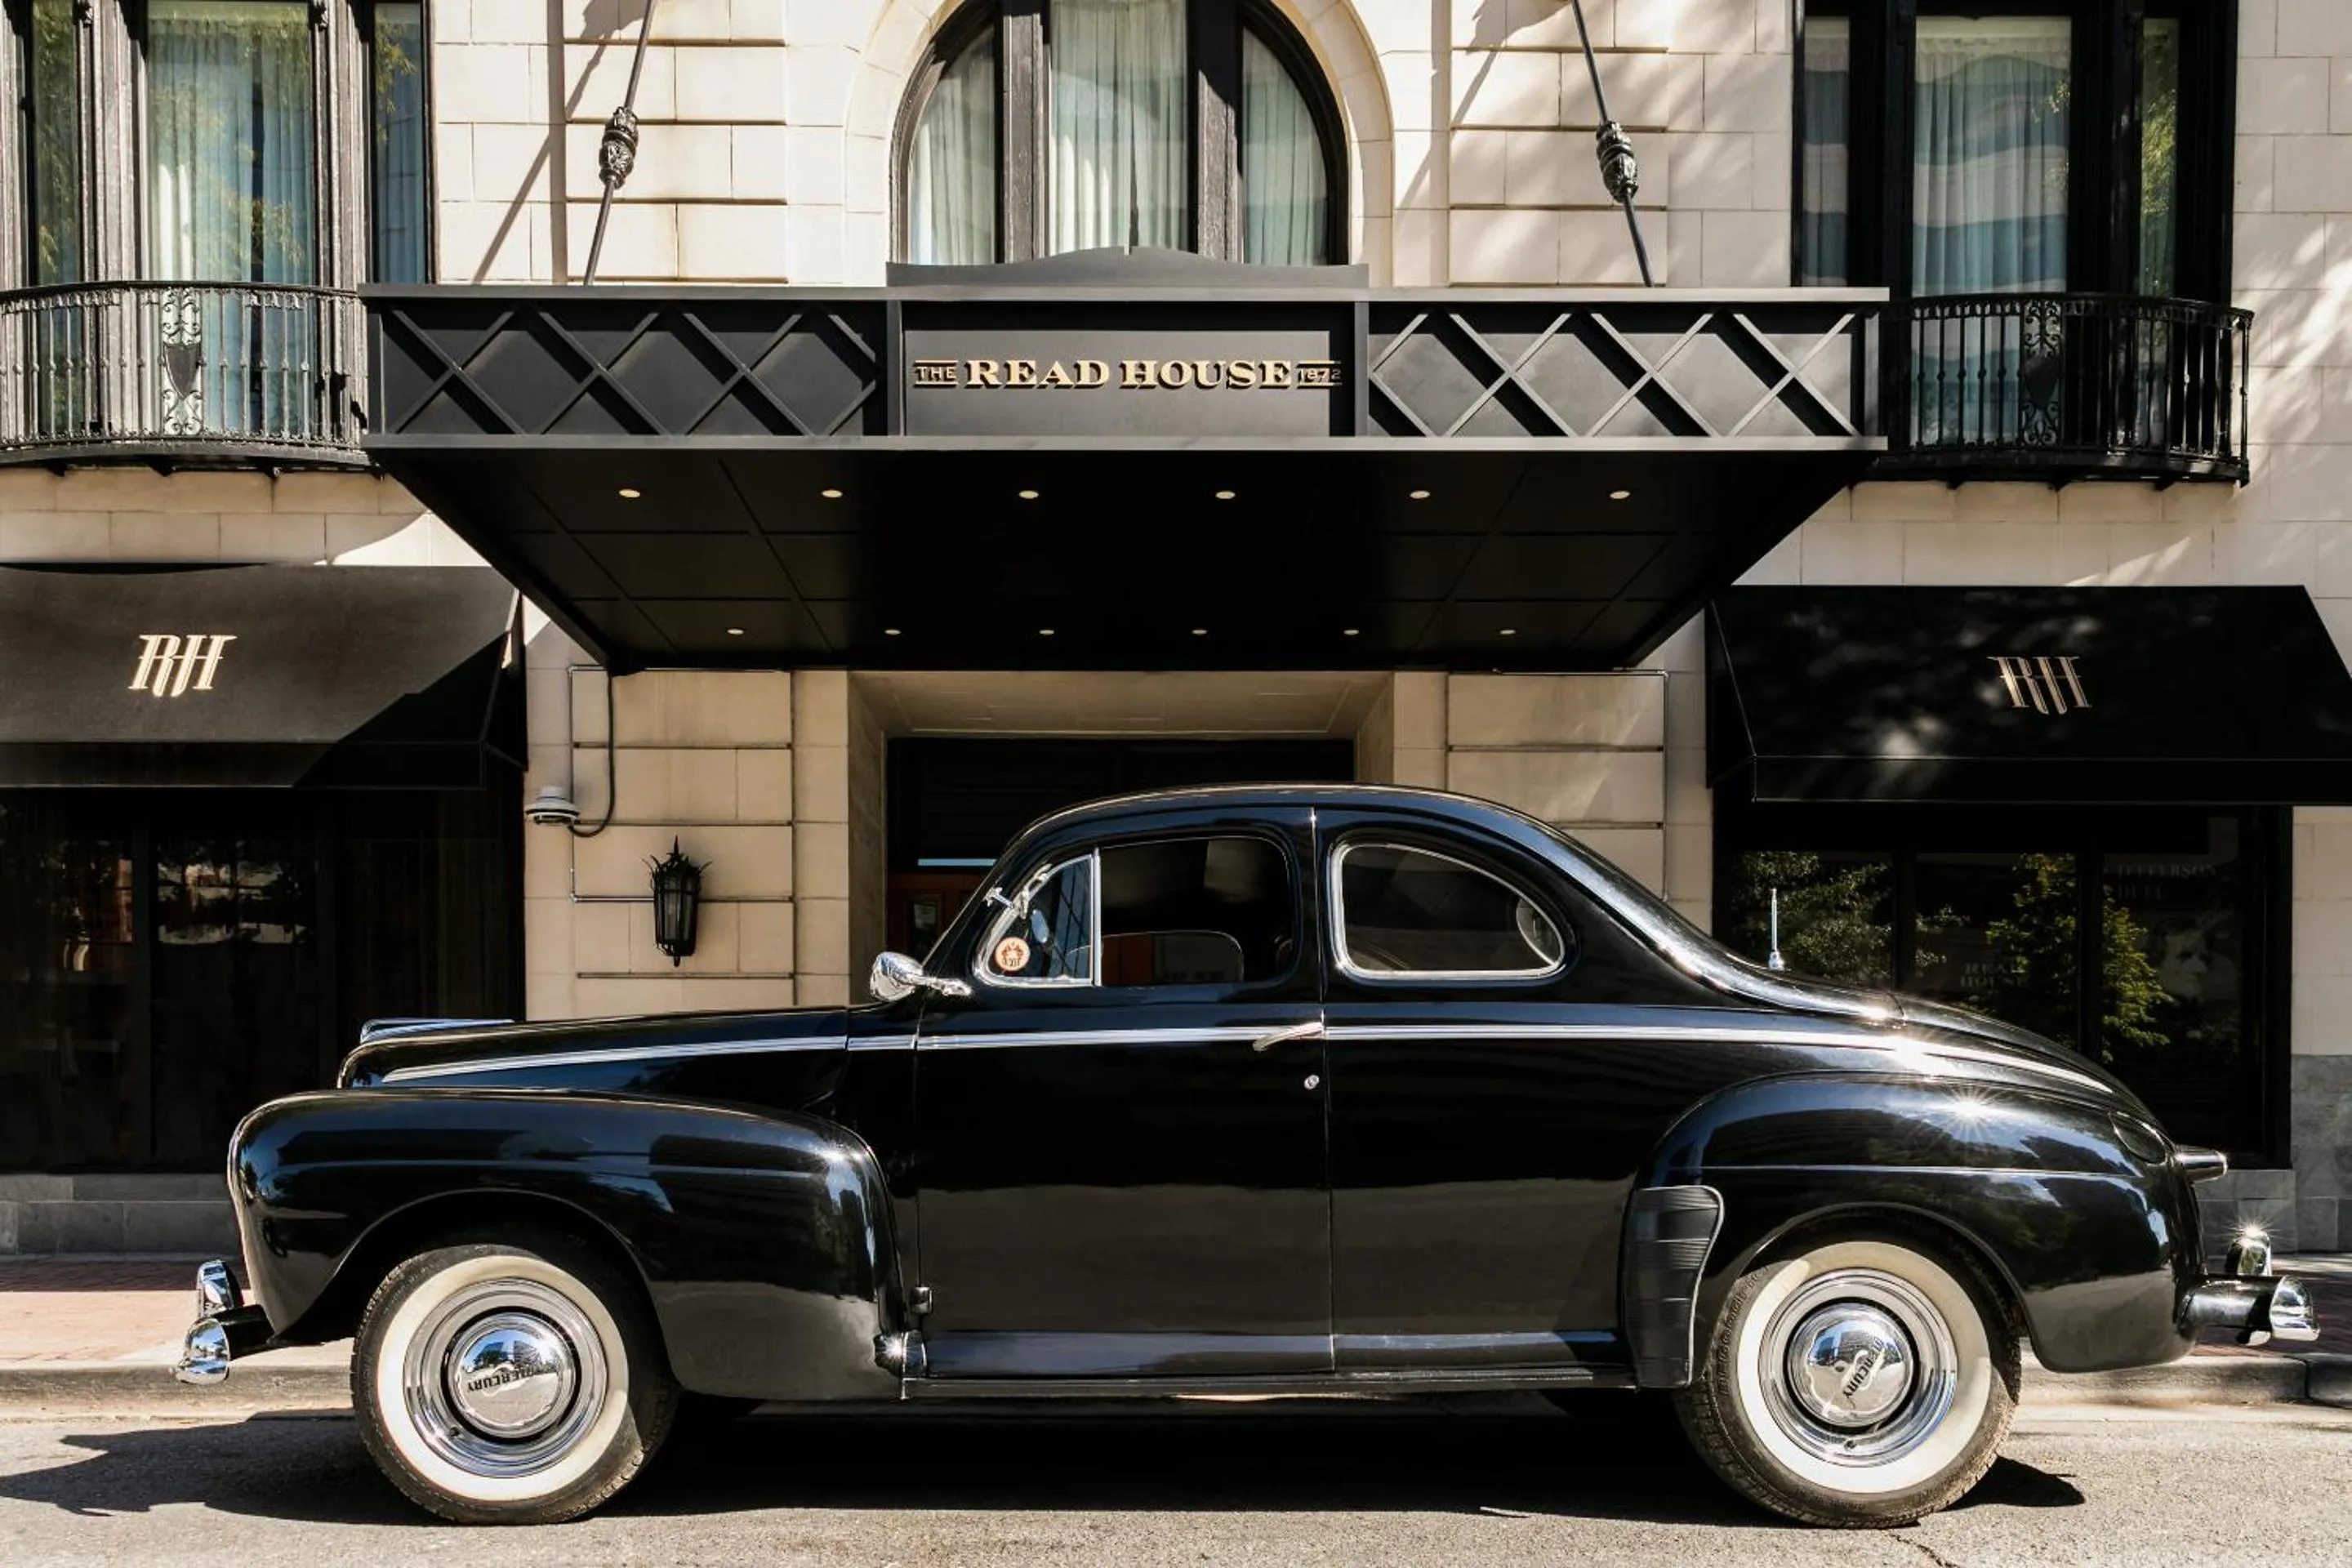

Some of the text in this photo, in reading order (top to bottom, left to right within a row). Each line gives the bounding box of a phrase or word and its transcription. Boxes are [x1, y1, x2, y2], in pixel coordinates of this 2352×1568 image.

[915, 359, 1341, 389] THE READ HOUSE 1872
[467, 1365, 533, 1392] MERCURY
